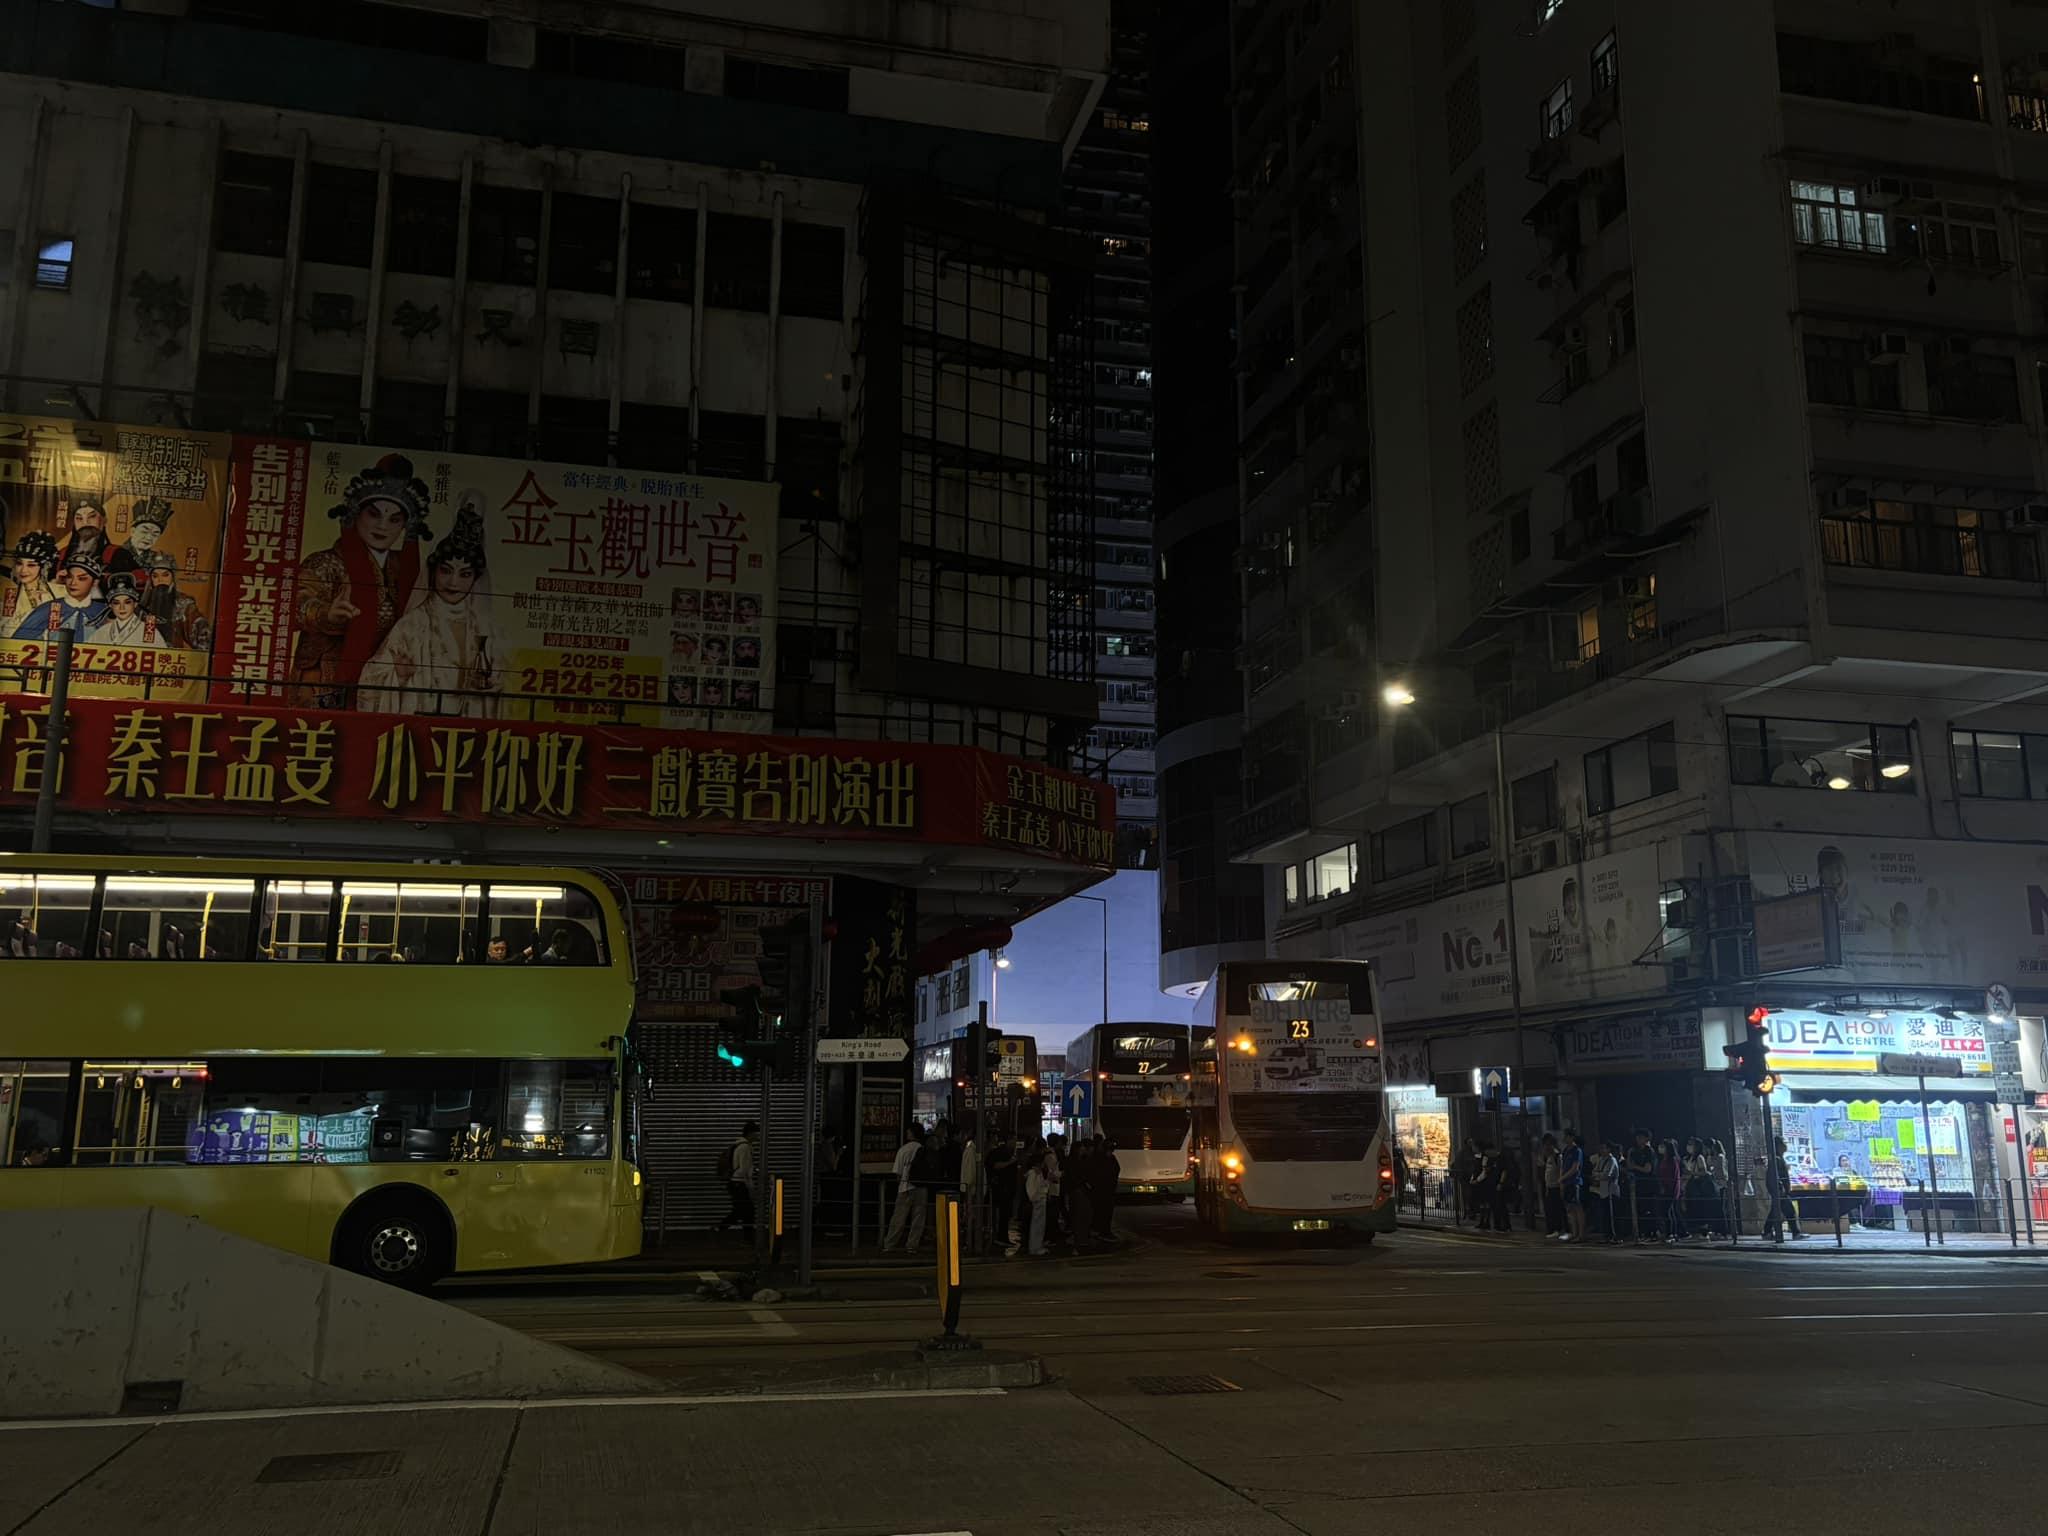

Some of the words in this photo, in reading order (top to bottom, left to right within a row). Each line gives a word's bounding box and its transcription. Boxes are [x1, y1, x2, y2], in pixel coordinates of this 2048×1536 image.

[151, 437, 209, 467] 特別南下
[115, 461, 208, 490] 紀念性演出
[501, 469, 749, 585] 金玉觀世音
[560, 653, 625, 670] 2025年
[520, 668, 660, 701] 2月24-25日
[104, 708, 337, 806] 秦王孟姜
[367, 722, 585, 817] 小平你好
[602, 740, 920, 829] 三戲寶告別演出
[1006, 764, 1097, 821] 金玉觀世音
[981, 800, 1051, 850] 秦王孟姜
[1291, 1020, 1311, 1039] 23
[1768, 1019, 1843, 1045] IDEA
[1845, 1020, 1895, 1035] HOM
[1906, 1017, 1983, 1037] 愛迪家
[1573, 1031, 1613, 1054] IDEA
[1847, 1036, 1896, 1046] CENTRE
[1137, 1062, 1150, 1074] 27
